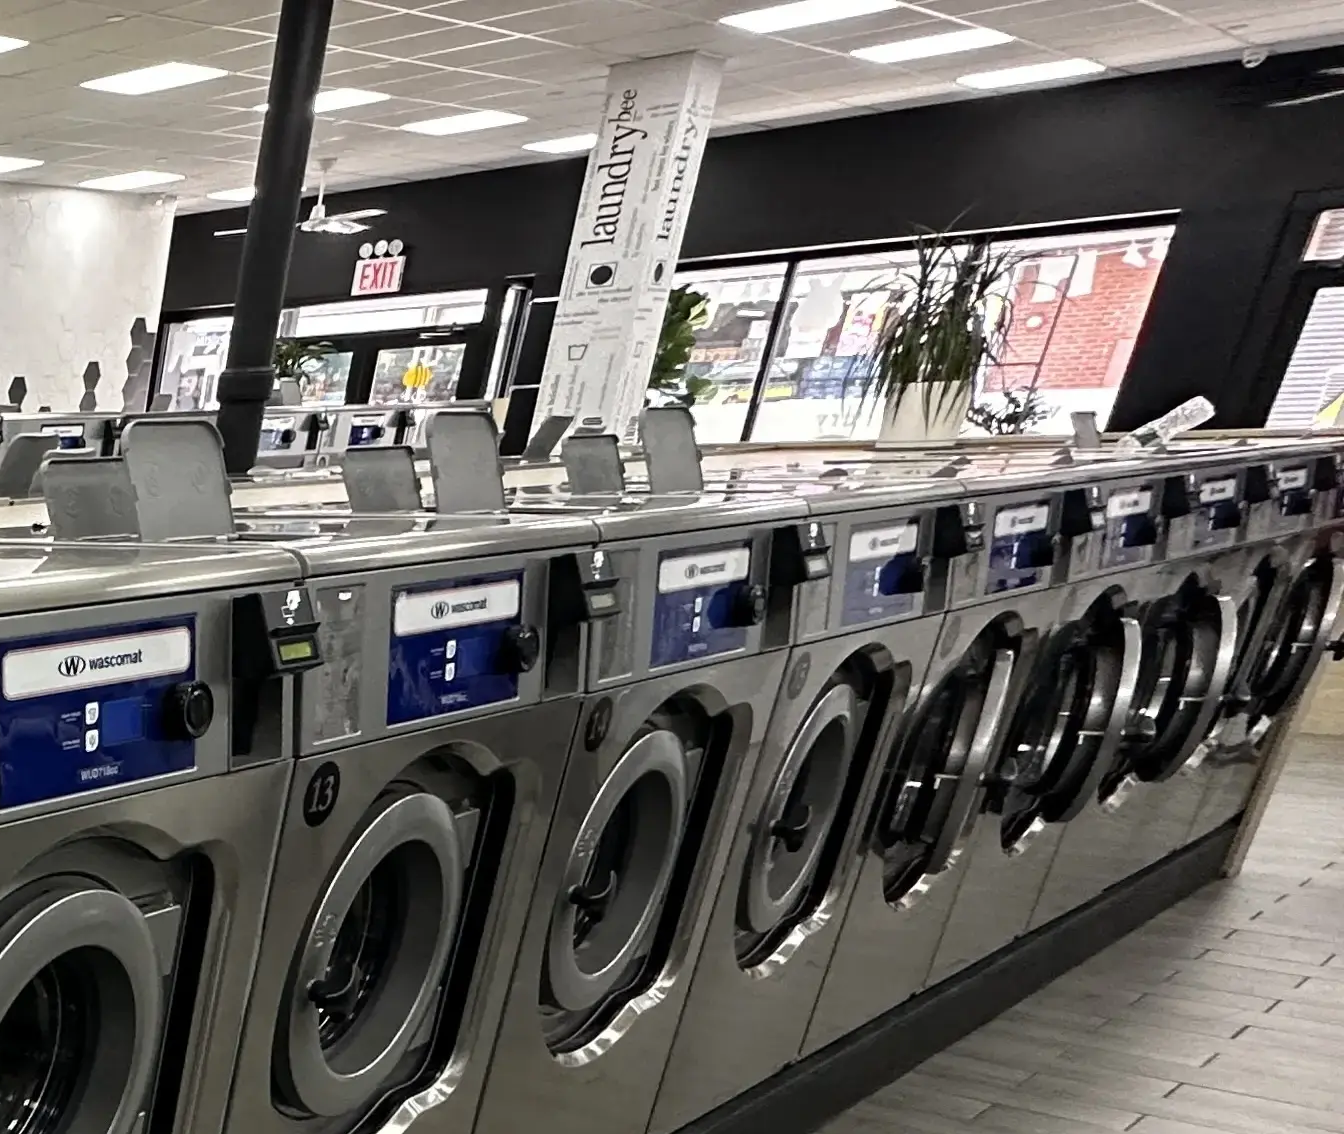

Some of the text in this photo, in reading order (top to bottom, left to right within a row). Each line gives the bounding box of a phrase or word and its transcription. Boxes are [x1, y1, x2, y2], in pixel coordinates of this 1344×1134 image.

[358, 260, 399, 292] EXIT
[89, 648, 143, 671] wascomat
[310, 774, 336, 814] 13
